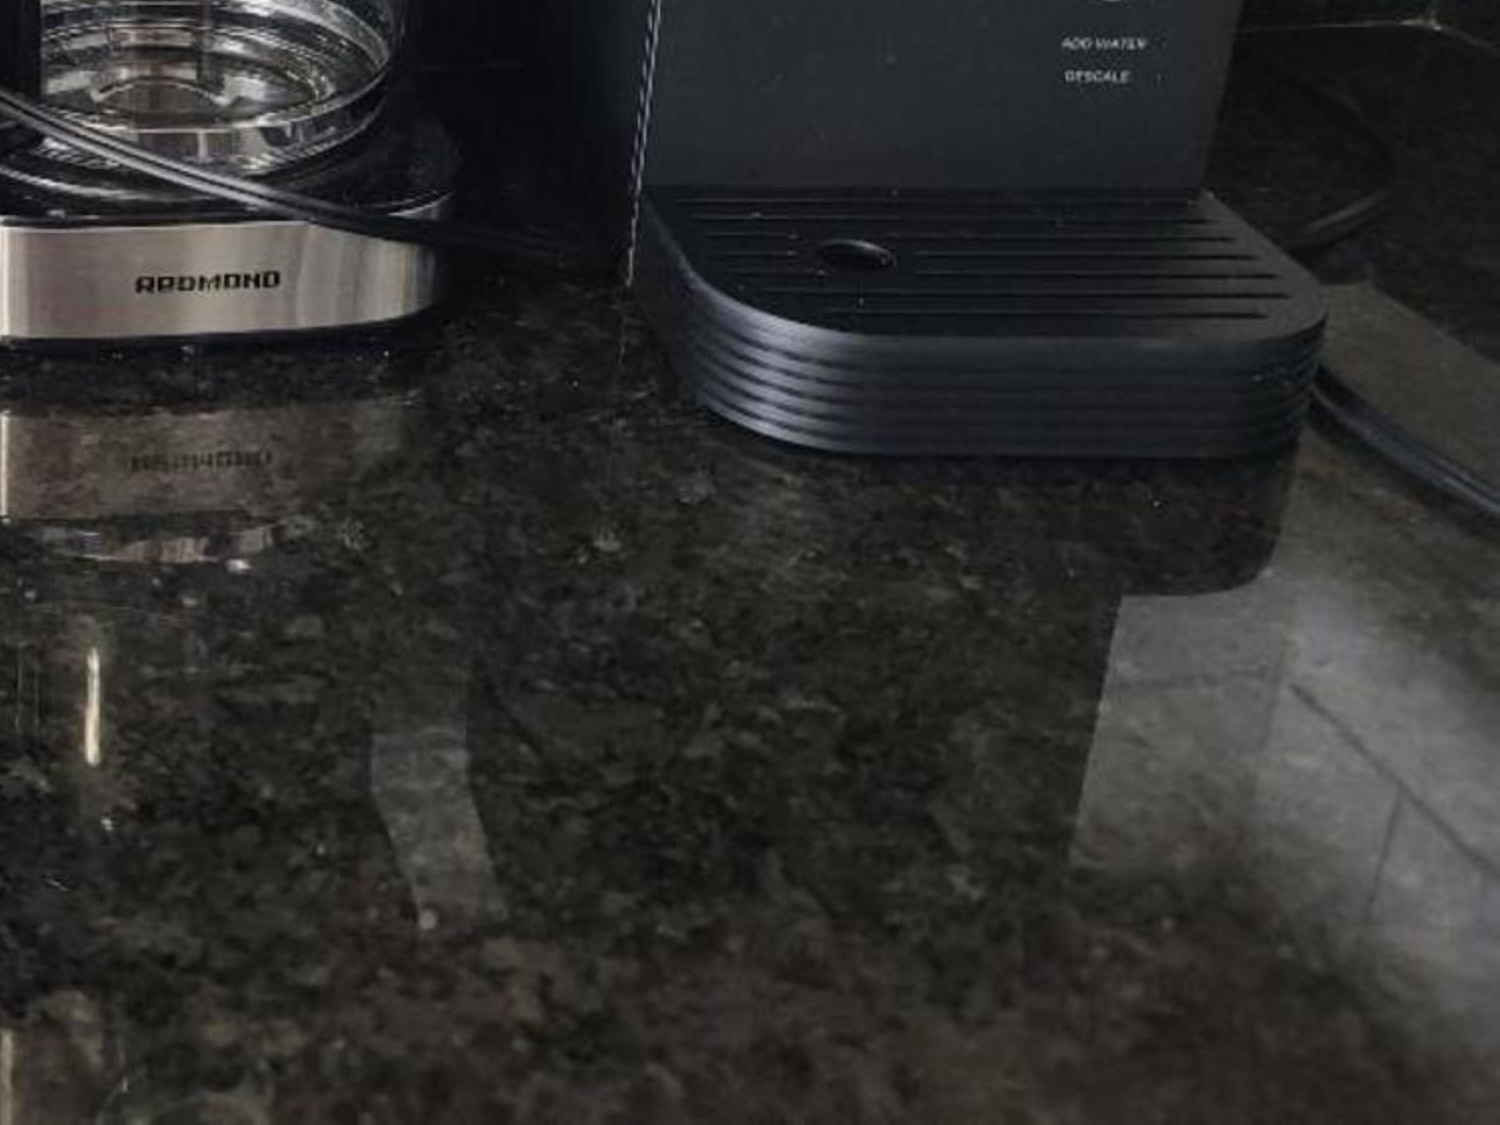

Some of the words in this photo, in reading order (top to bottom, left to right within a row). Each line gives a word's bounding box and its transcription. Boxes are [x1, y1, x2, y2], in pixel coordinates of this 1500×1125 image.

[1062, 36, 1092, 50] ADD
[1095, 36, 1148, 50] WATER
[1064, 69, 1131, 84] DESCALE
